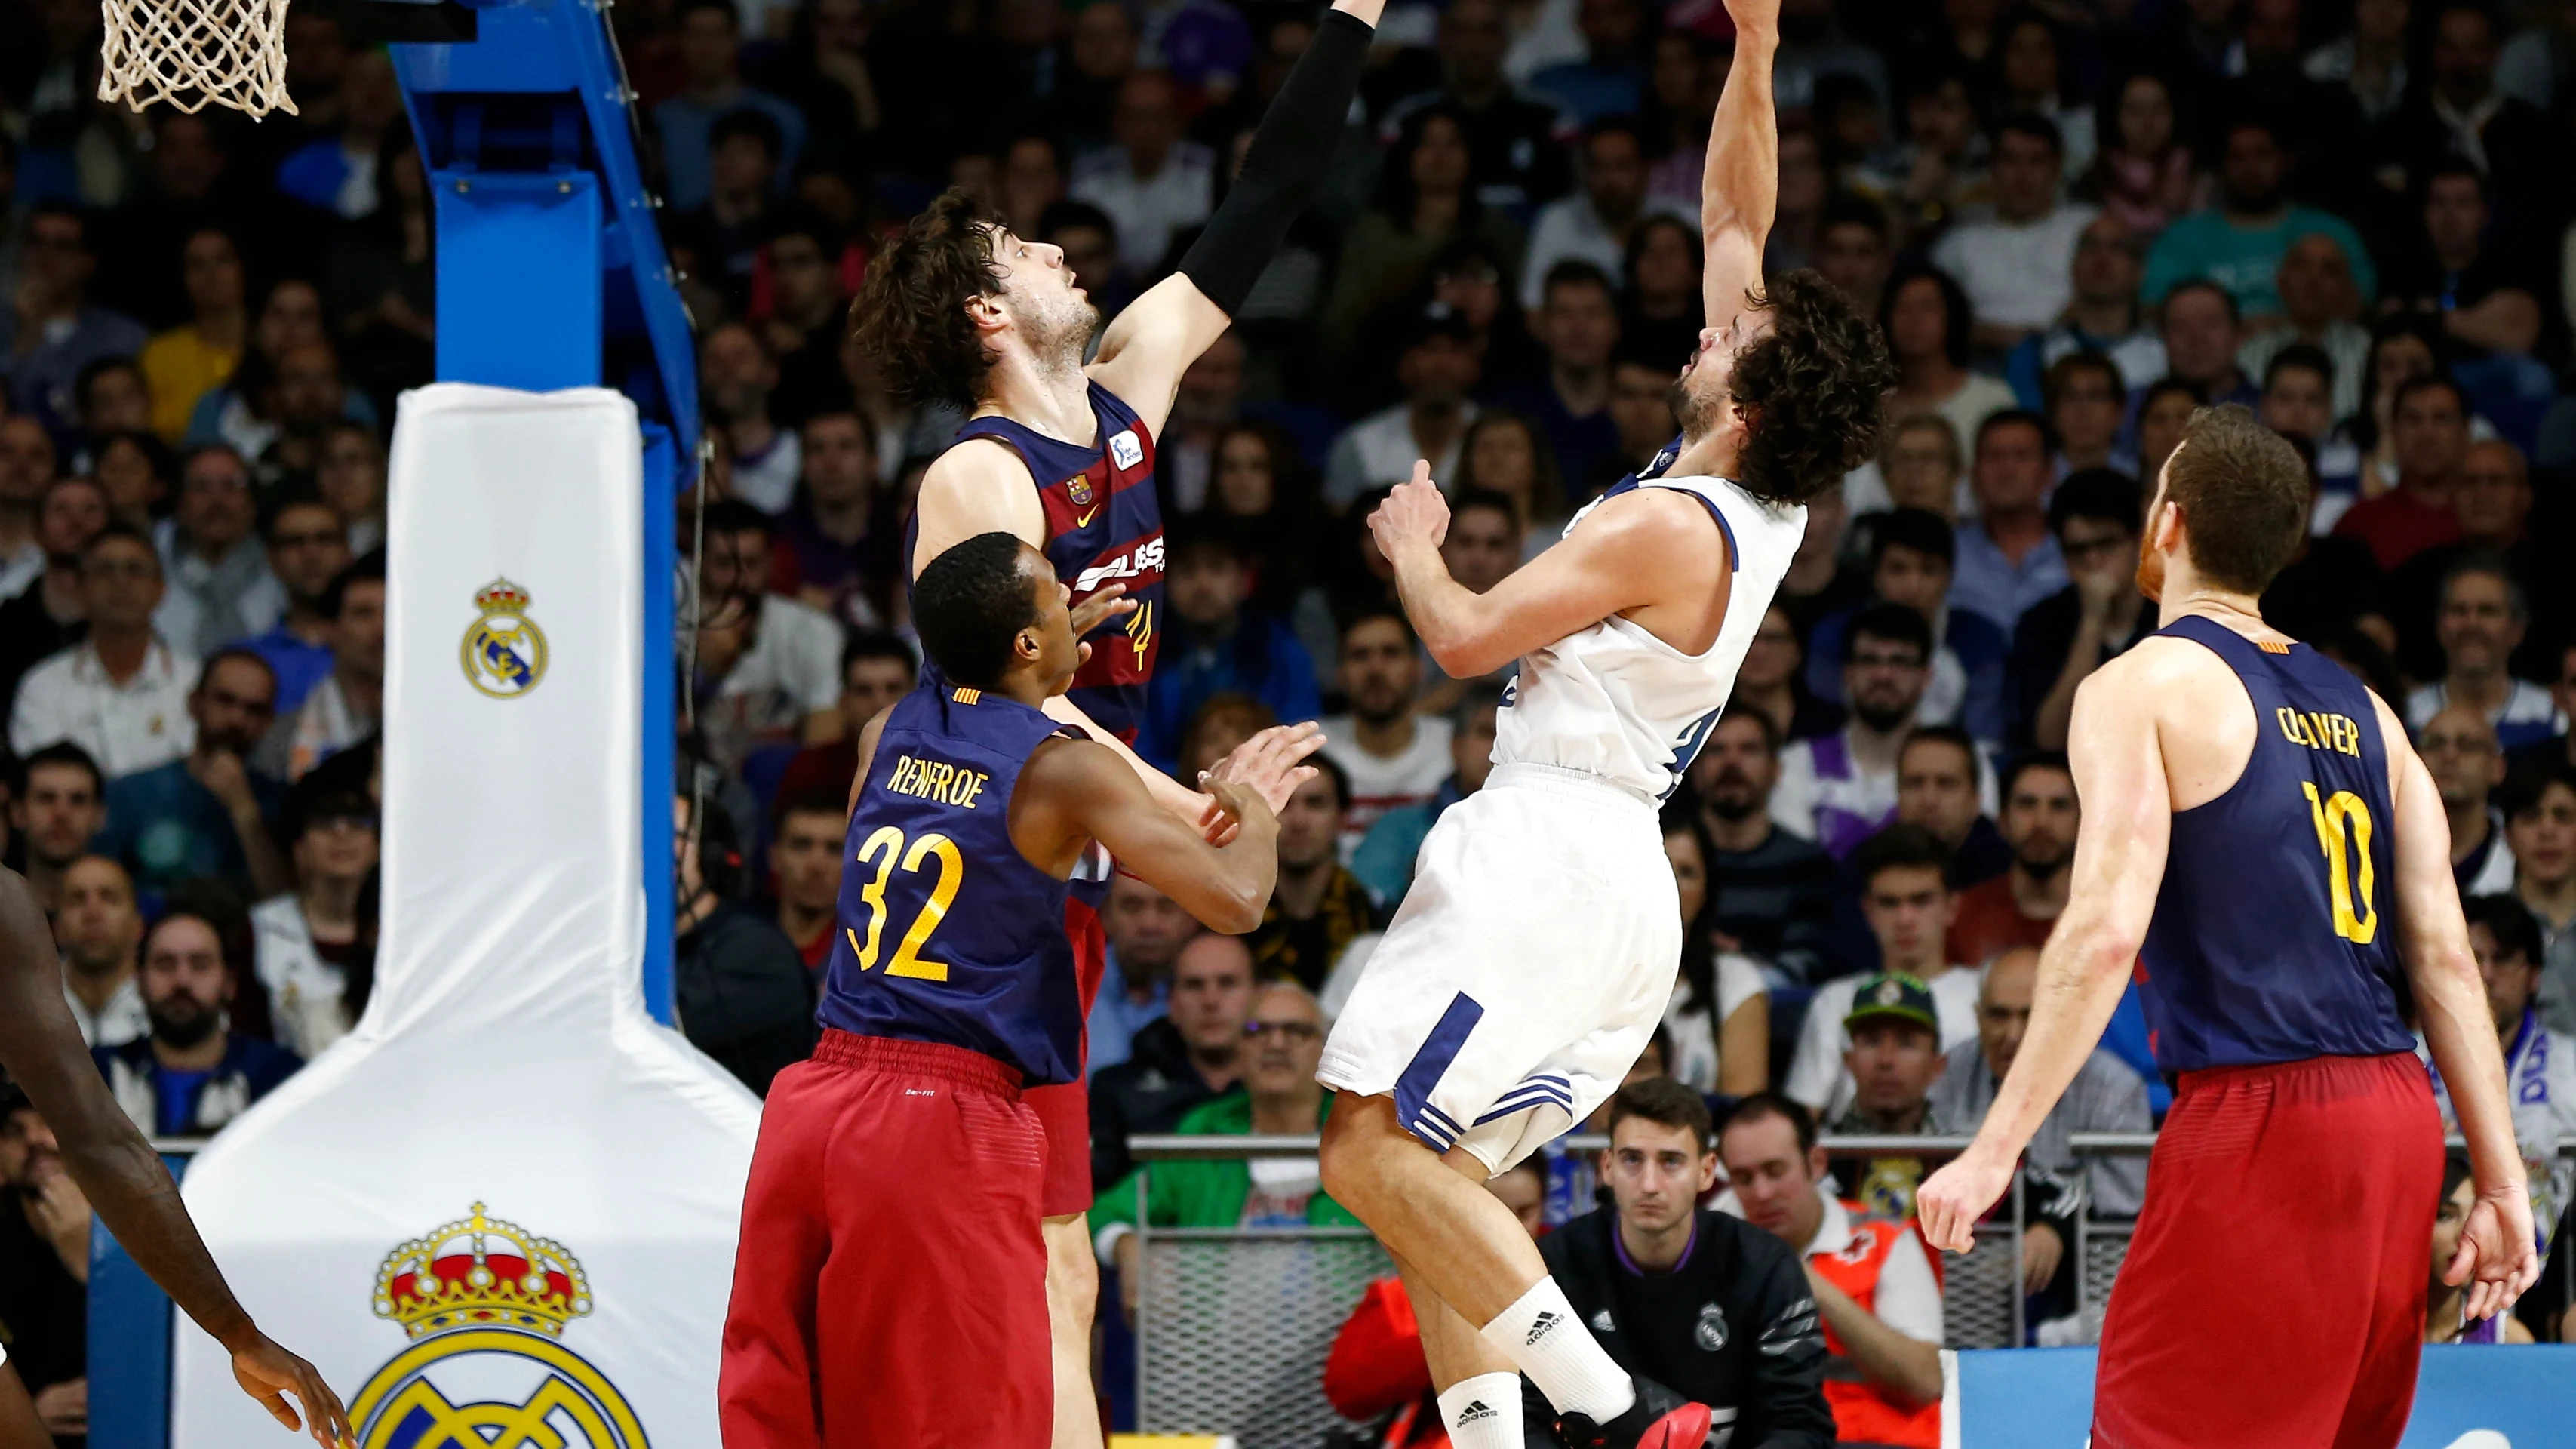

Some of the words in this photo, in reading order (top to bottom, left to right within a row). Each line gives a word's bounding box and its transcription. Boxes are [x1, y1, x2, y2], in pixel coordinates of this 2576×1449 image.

[886, 754, 989, 810] RENFROE
[2302, 780, 2378, 945] 10
[847, 826, 964, 983] 32
[1526, 1313, 1566, 1346] adidas
[1456, 1409, 1498, 1429] adidas
